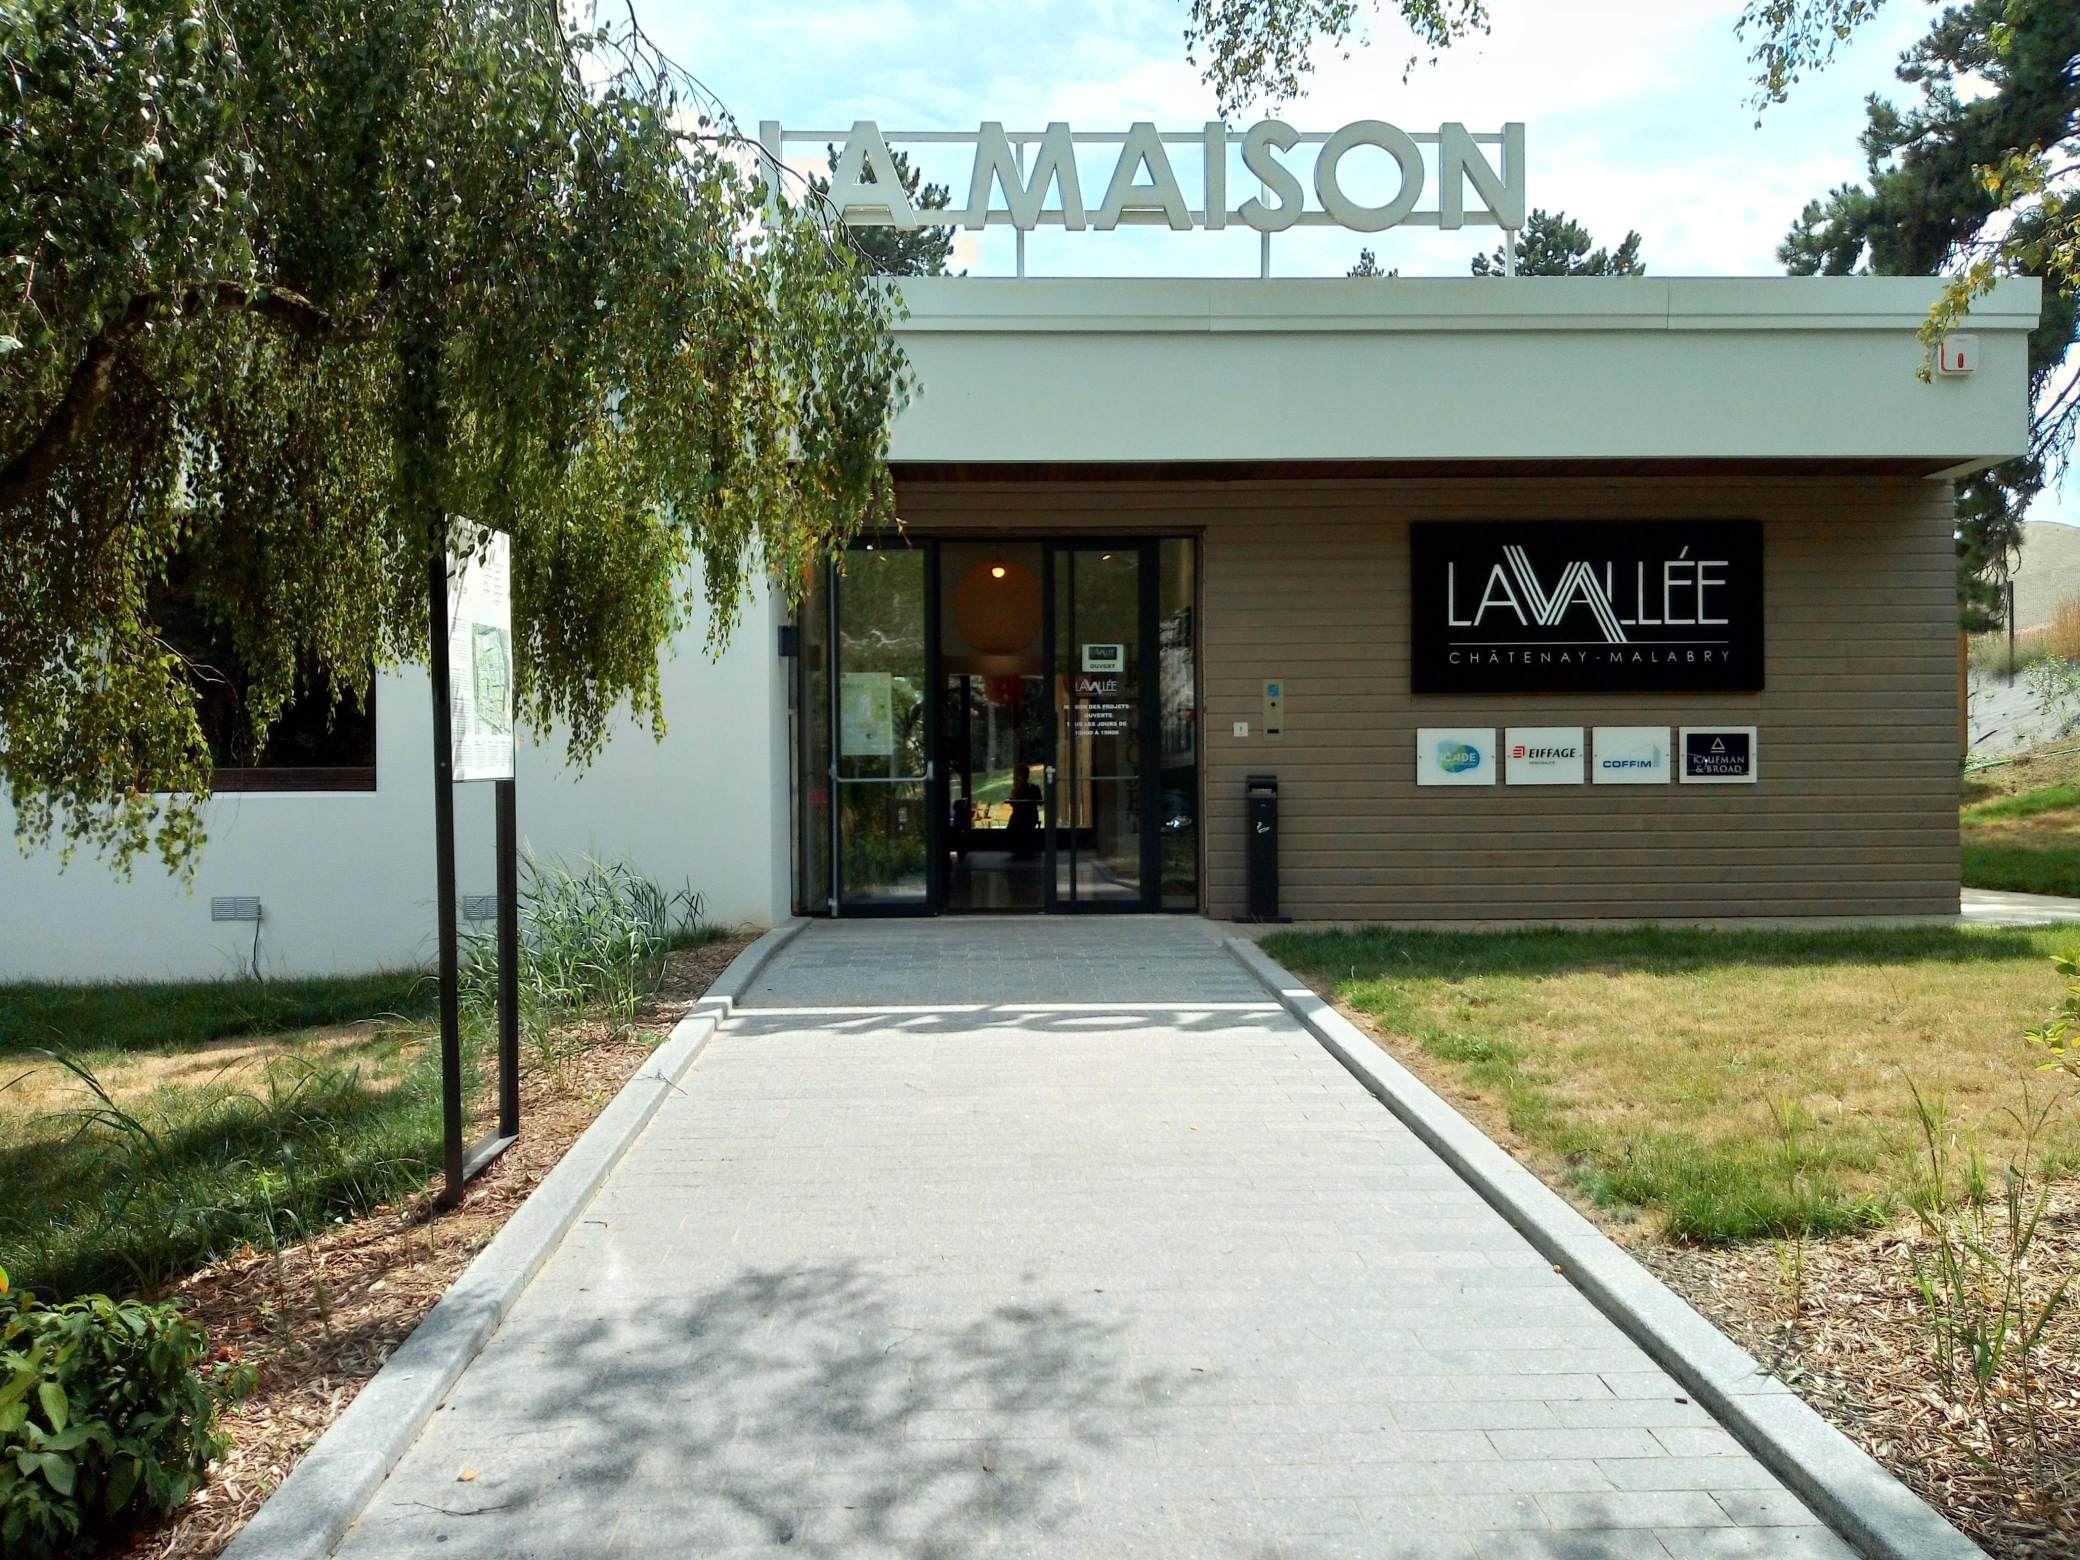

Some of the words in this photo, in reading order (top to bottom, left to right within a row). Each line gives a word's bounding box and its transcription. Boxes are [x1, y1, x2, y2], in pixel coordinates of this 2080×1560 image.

[966, 119, 1525, 232] MAISON
[1529, 748, 1576, 758] EIFFAGE
[1603, 760, 1651, 768] COFFIM
[1693, 755, 1744, 764] KAUFMAN
[1695, 764, 1704, 773] &
[1706, 764, 1742, 773] BROAD
